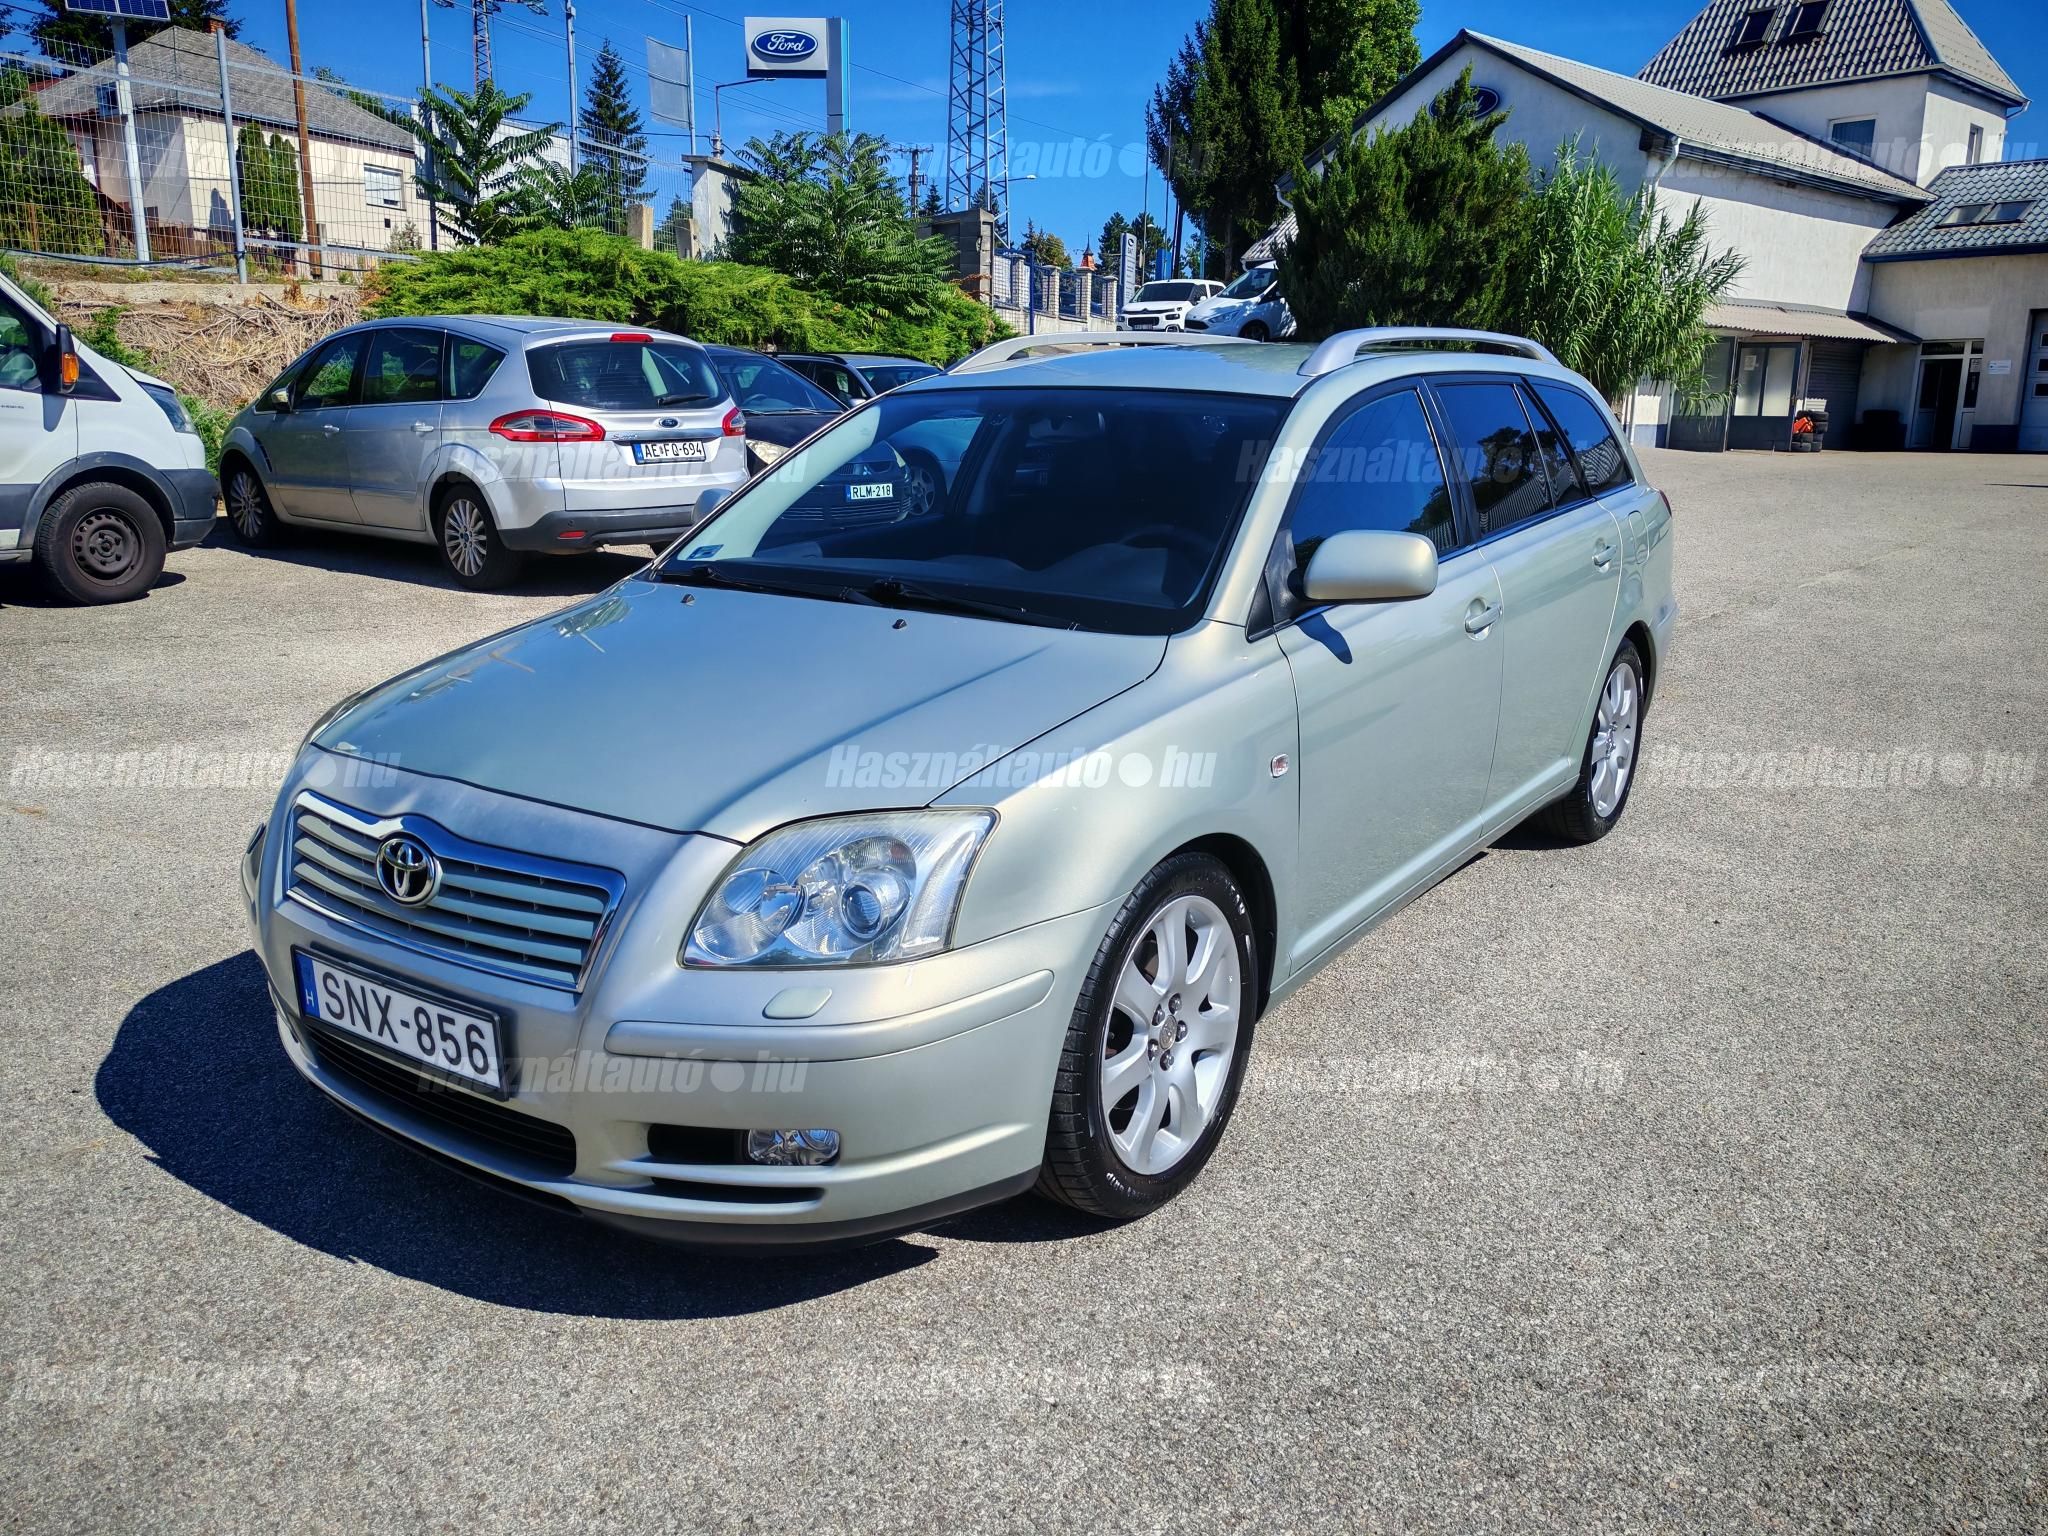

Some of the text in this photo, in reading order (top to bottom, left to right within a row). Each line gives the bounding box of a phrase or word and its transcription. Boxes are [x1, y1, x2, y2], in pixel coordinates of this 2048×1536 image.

[767, 33, 805, 51] Ford
[852, 484, 891, 498] RLM-218
[305, 989, 315, 1009] H
[322, 971, 490, 1076] SNX-856
